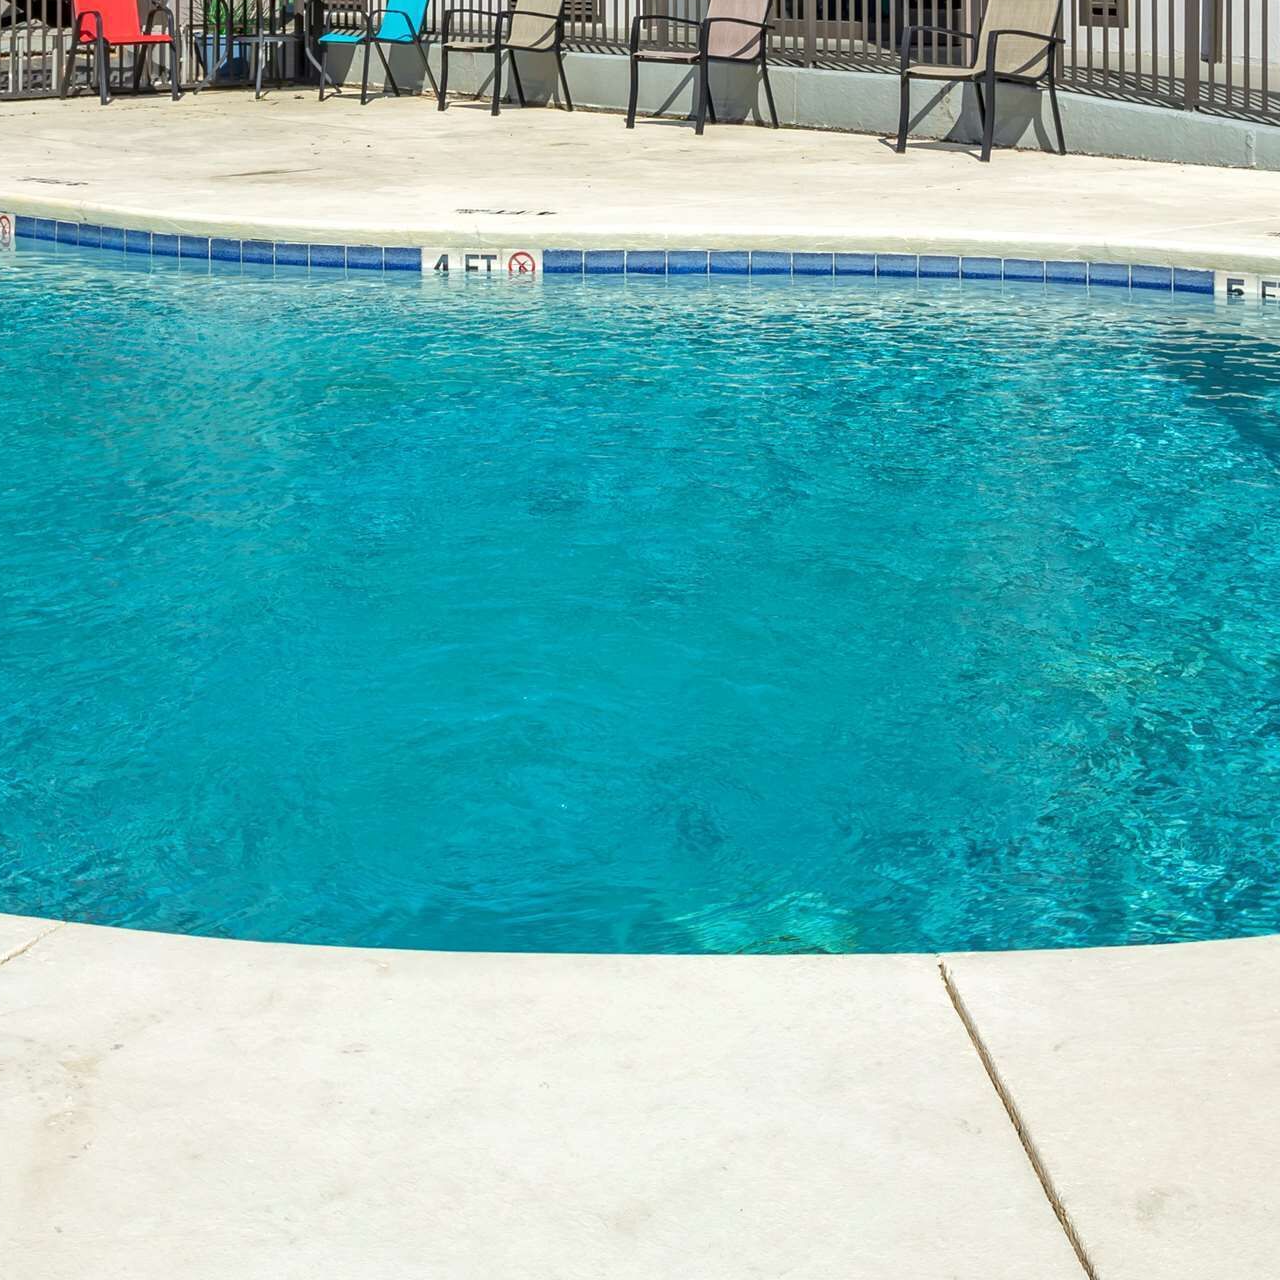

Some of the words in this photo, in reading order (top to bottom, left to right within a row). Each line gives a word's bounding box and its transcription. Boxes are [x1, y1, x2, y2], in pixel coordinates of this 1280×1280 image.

[433, 253, 450, 274] 4
[464, 254, 498, 274] FT
[1226, 277, 1245, 297] 5
